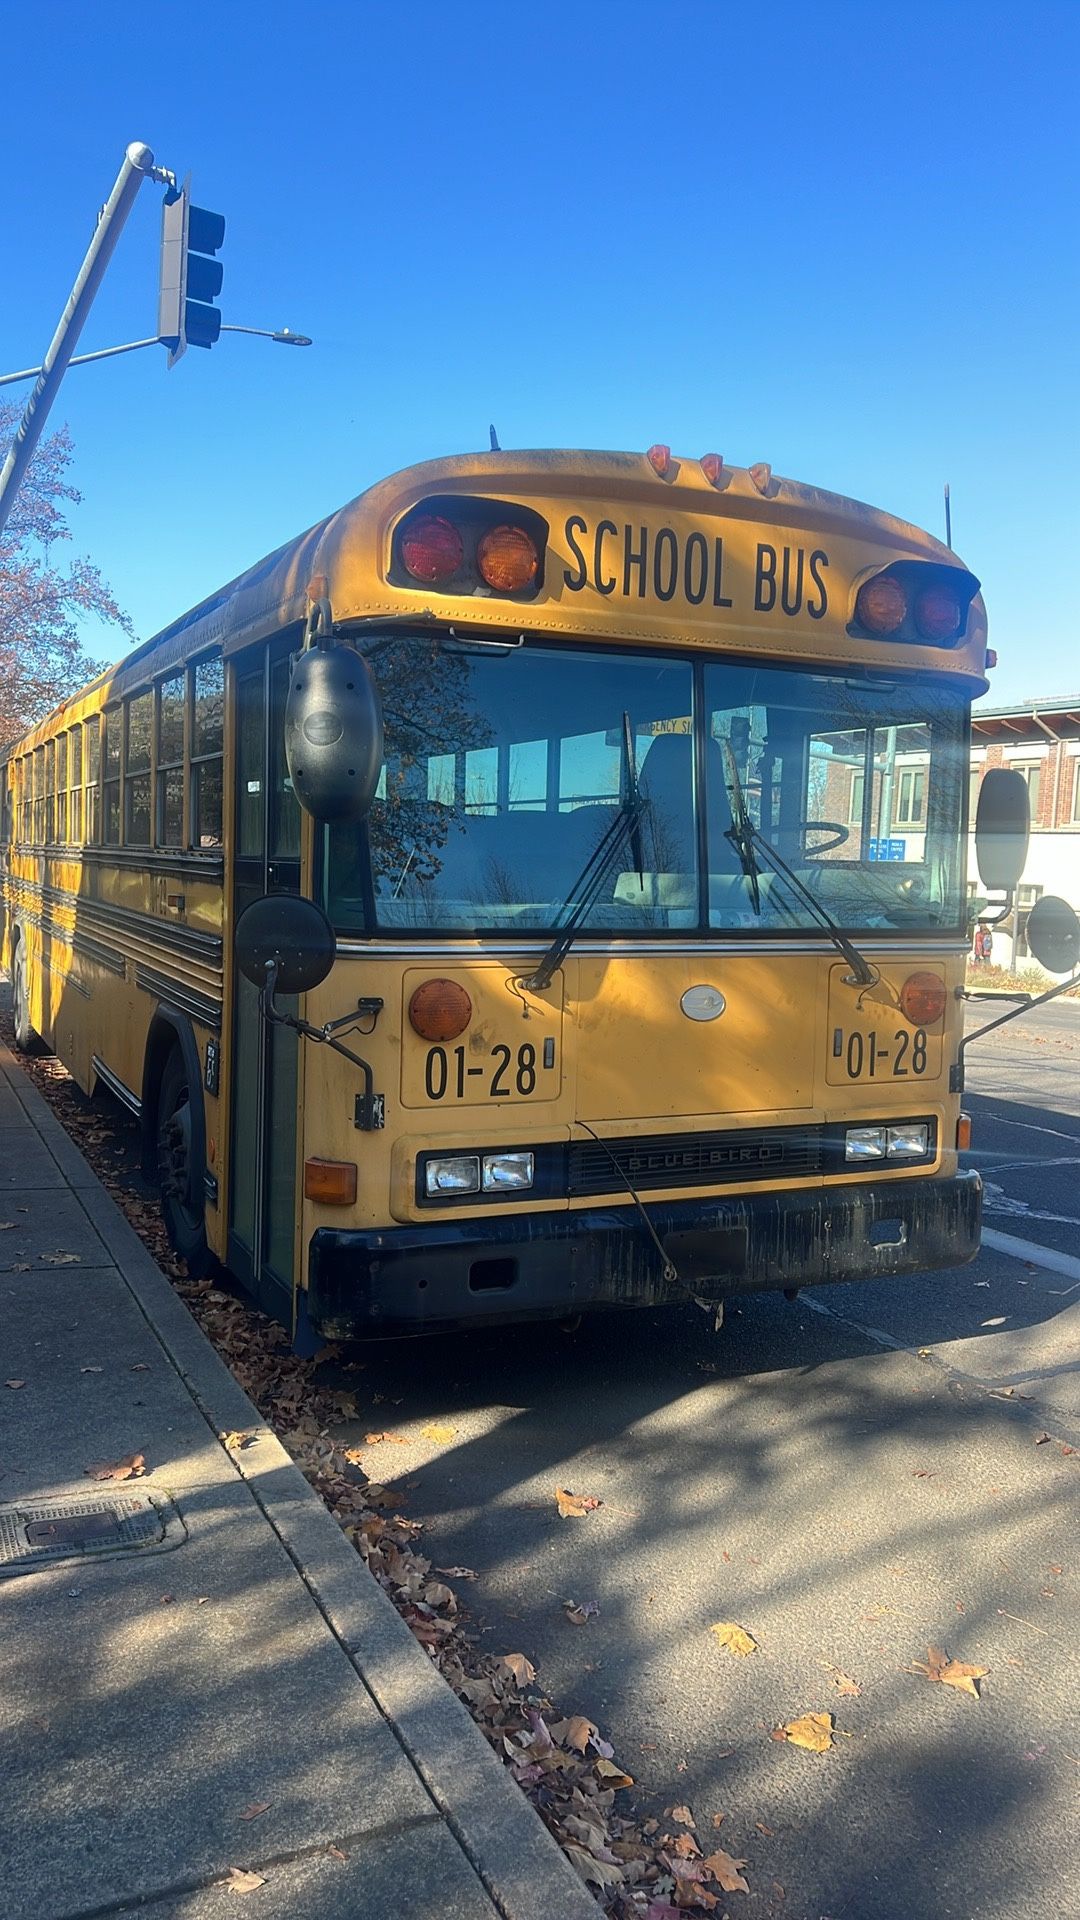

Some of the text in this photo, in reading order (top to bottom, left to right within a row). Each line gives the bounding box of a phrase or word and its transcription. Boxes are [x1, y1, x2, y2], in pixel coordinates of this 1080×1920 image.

[563, 515, 829, 620] SCHOOL BUS
[425, 1043, 536, 1100] 01-28
[847, 1028, 927, 1079] 01-28
[628, 1147, 771, 1170] BLUE BIRD
